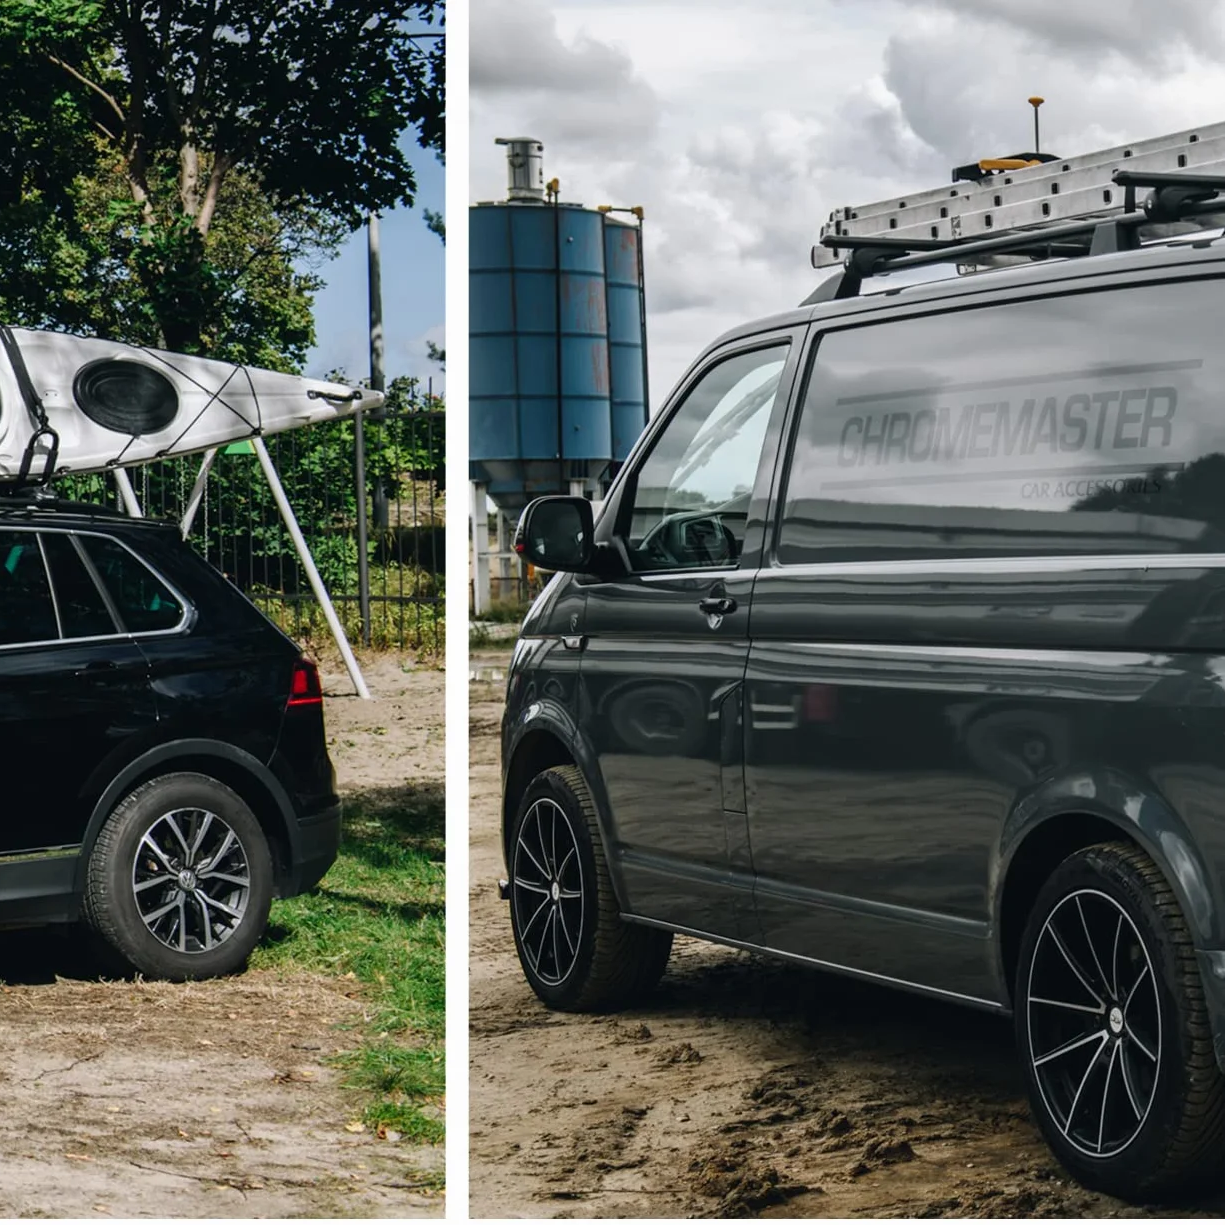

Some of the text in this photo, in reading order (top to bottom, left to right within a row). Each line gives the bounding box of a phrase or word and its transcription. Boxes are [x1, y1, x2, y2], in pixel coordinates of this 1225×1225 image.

[837, 386, 1178, 468] CHROMEMASTER
[1021, 478, 1162, 500] CAR ACCESSORIES
